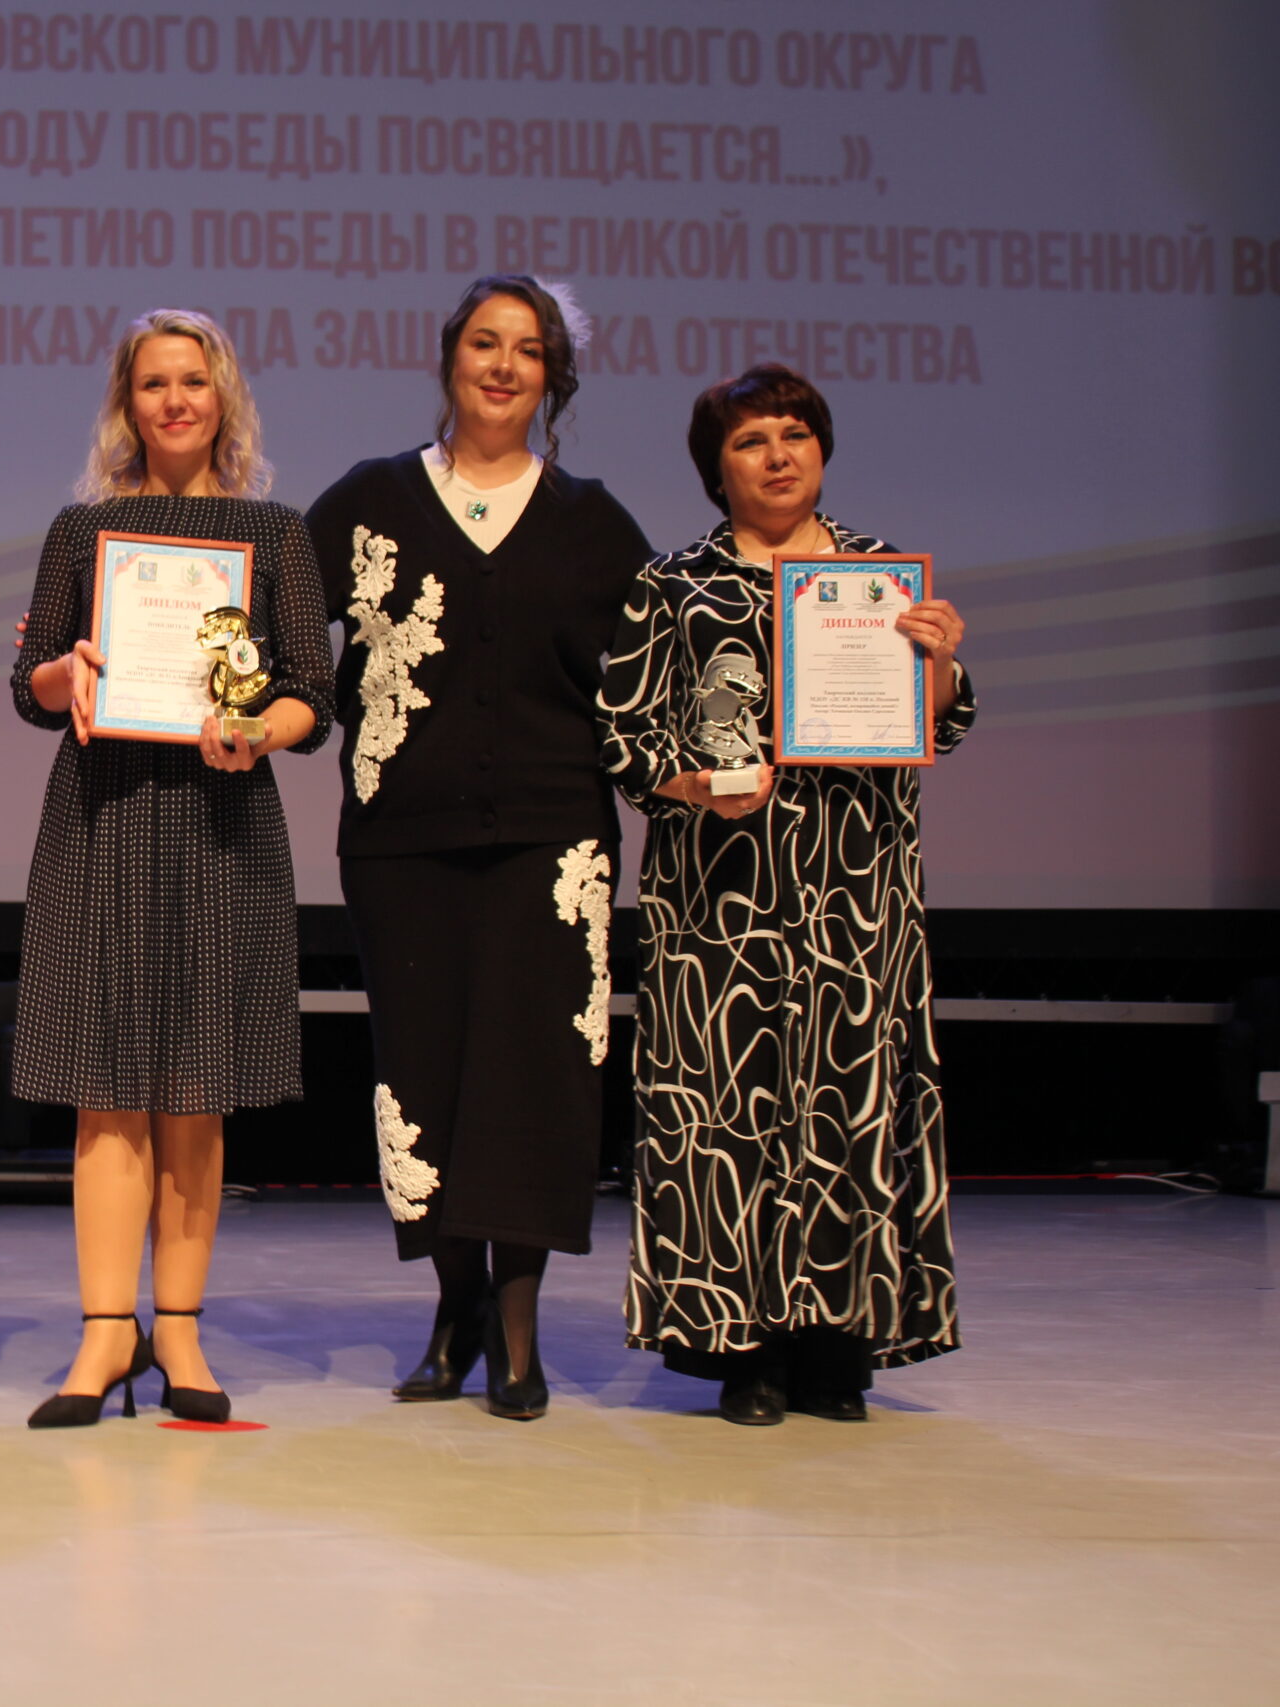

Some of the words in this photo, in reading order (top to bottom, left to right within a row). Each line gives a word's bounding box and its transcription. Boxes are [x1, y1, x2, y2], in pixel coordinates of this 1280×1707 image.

[235, 16, 761, 88] МУНИЦИПАЛЬНОГО
[775, 31, 987, 96] ОКРУГА
[126, 111, 361, 180] ПОБЕДЫ
[192, 210, 428, 279] ПОБЕДЫ
[445, 213, 479, 274] В
[495, 209, 750, 282] ВЕЛИКОЙ
[765, 222, 1215, 296] ОТЕЧЕСТВЕННОЙ
[675, 317, 983, 386] ОТЕЧЕСТВА
[138, 596, 202, 611] ДИПЛОМ
[820, 617, 886, 629] ДИПЛОМ
